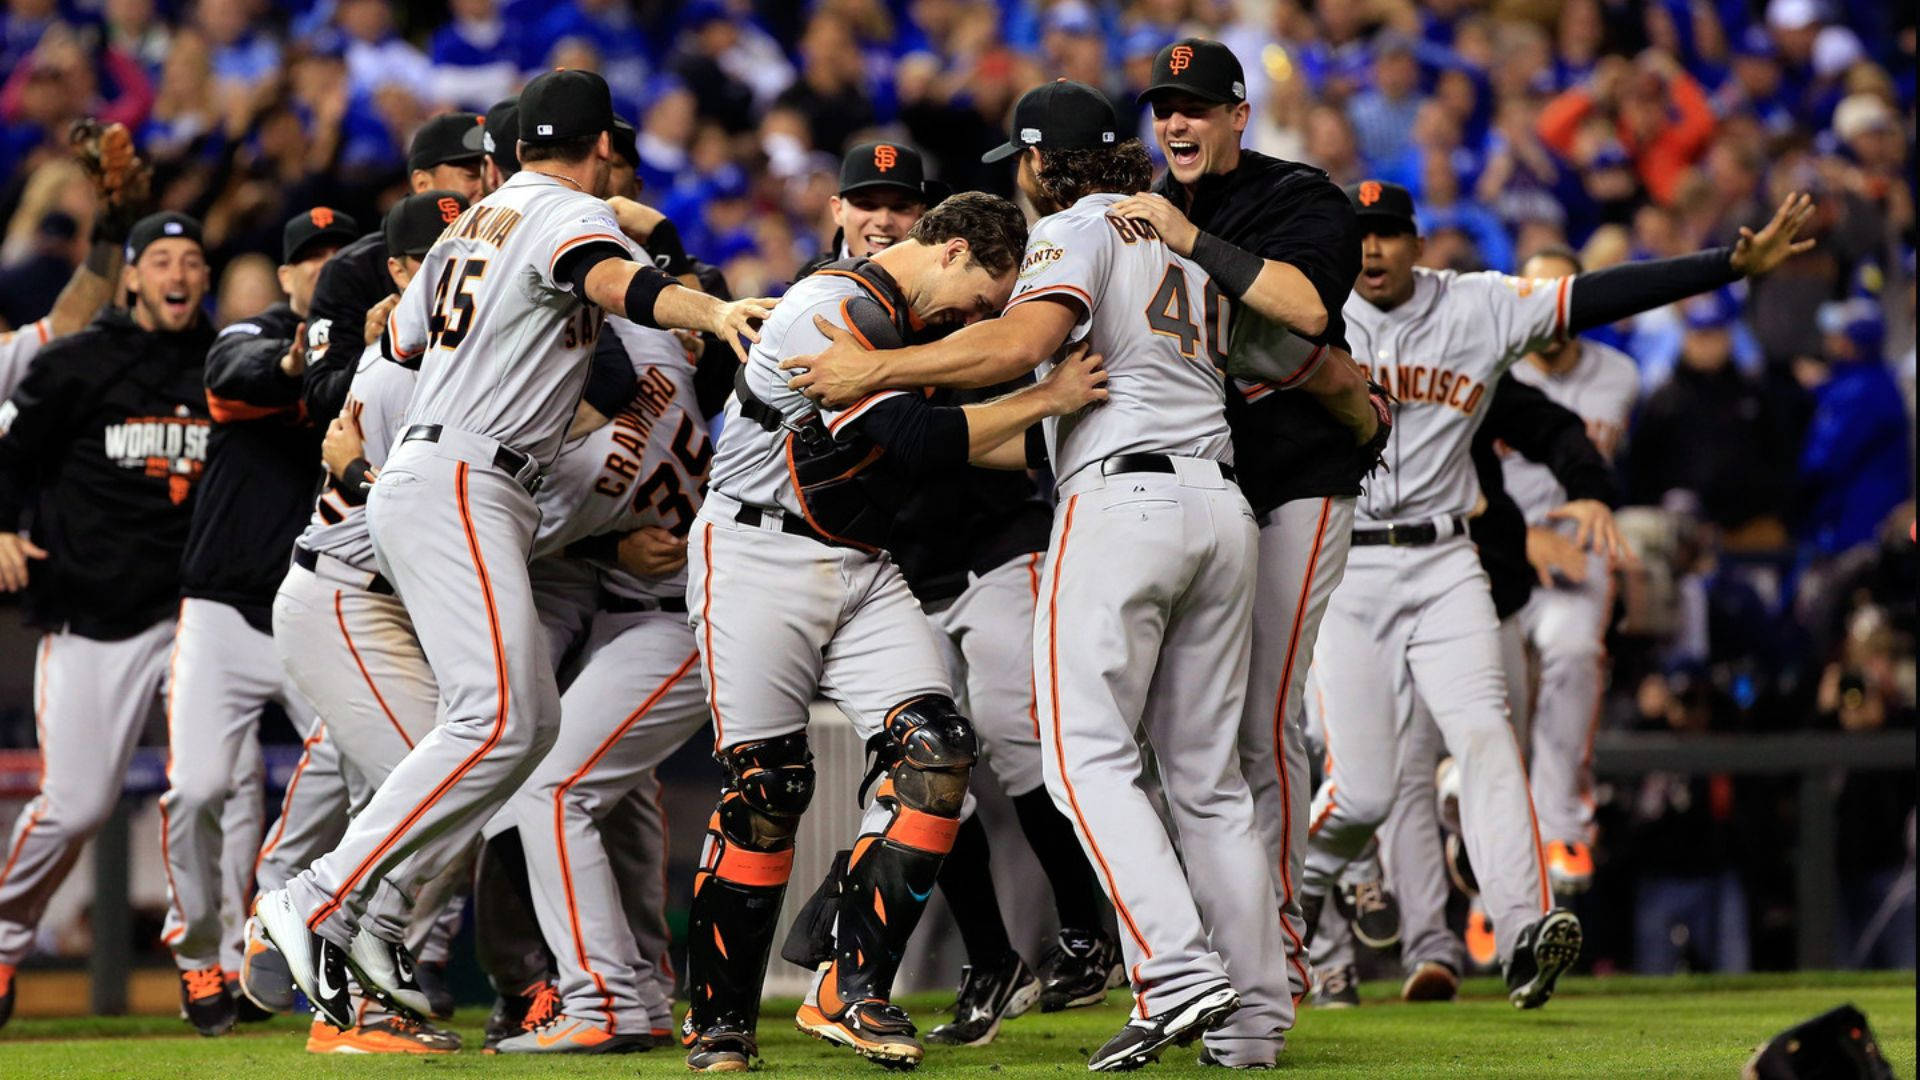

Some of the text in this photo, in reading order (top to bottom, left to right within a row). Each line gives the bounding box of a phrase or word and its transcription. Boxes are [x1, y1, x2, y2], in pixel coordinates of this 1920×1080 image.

[1169, 46, 1194, 76] SF
[874, 144, 897, 173] SF
[428, 256, 490, 351] 45
[1146, 261, 1229, 377] 40
[1359, 363, 1485, 416] ANCISCO
[105, 422, 183, 460] WORLD
[595, 364, 676, 498] CRAWFORD
[631, 408, 714, 537] 35
